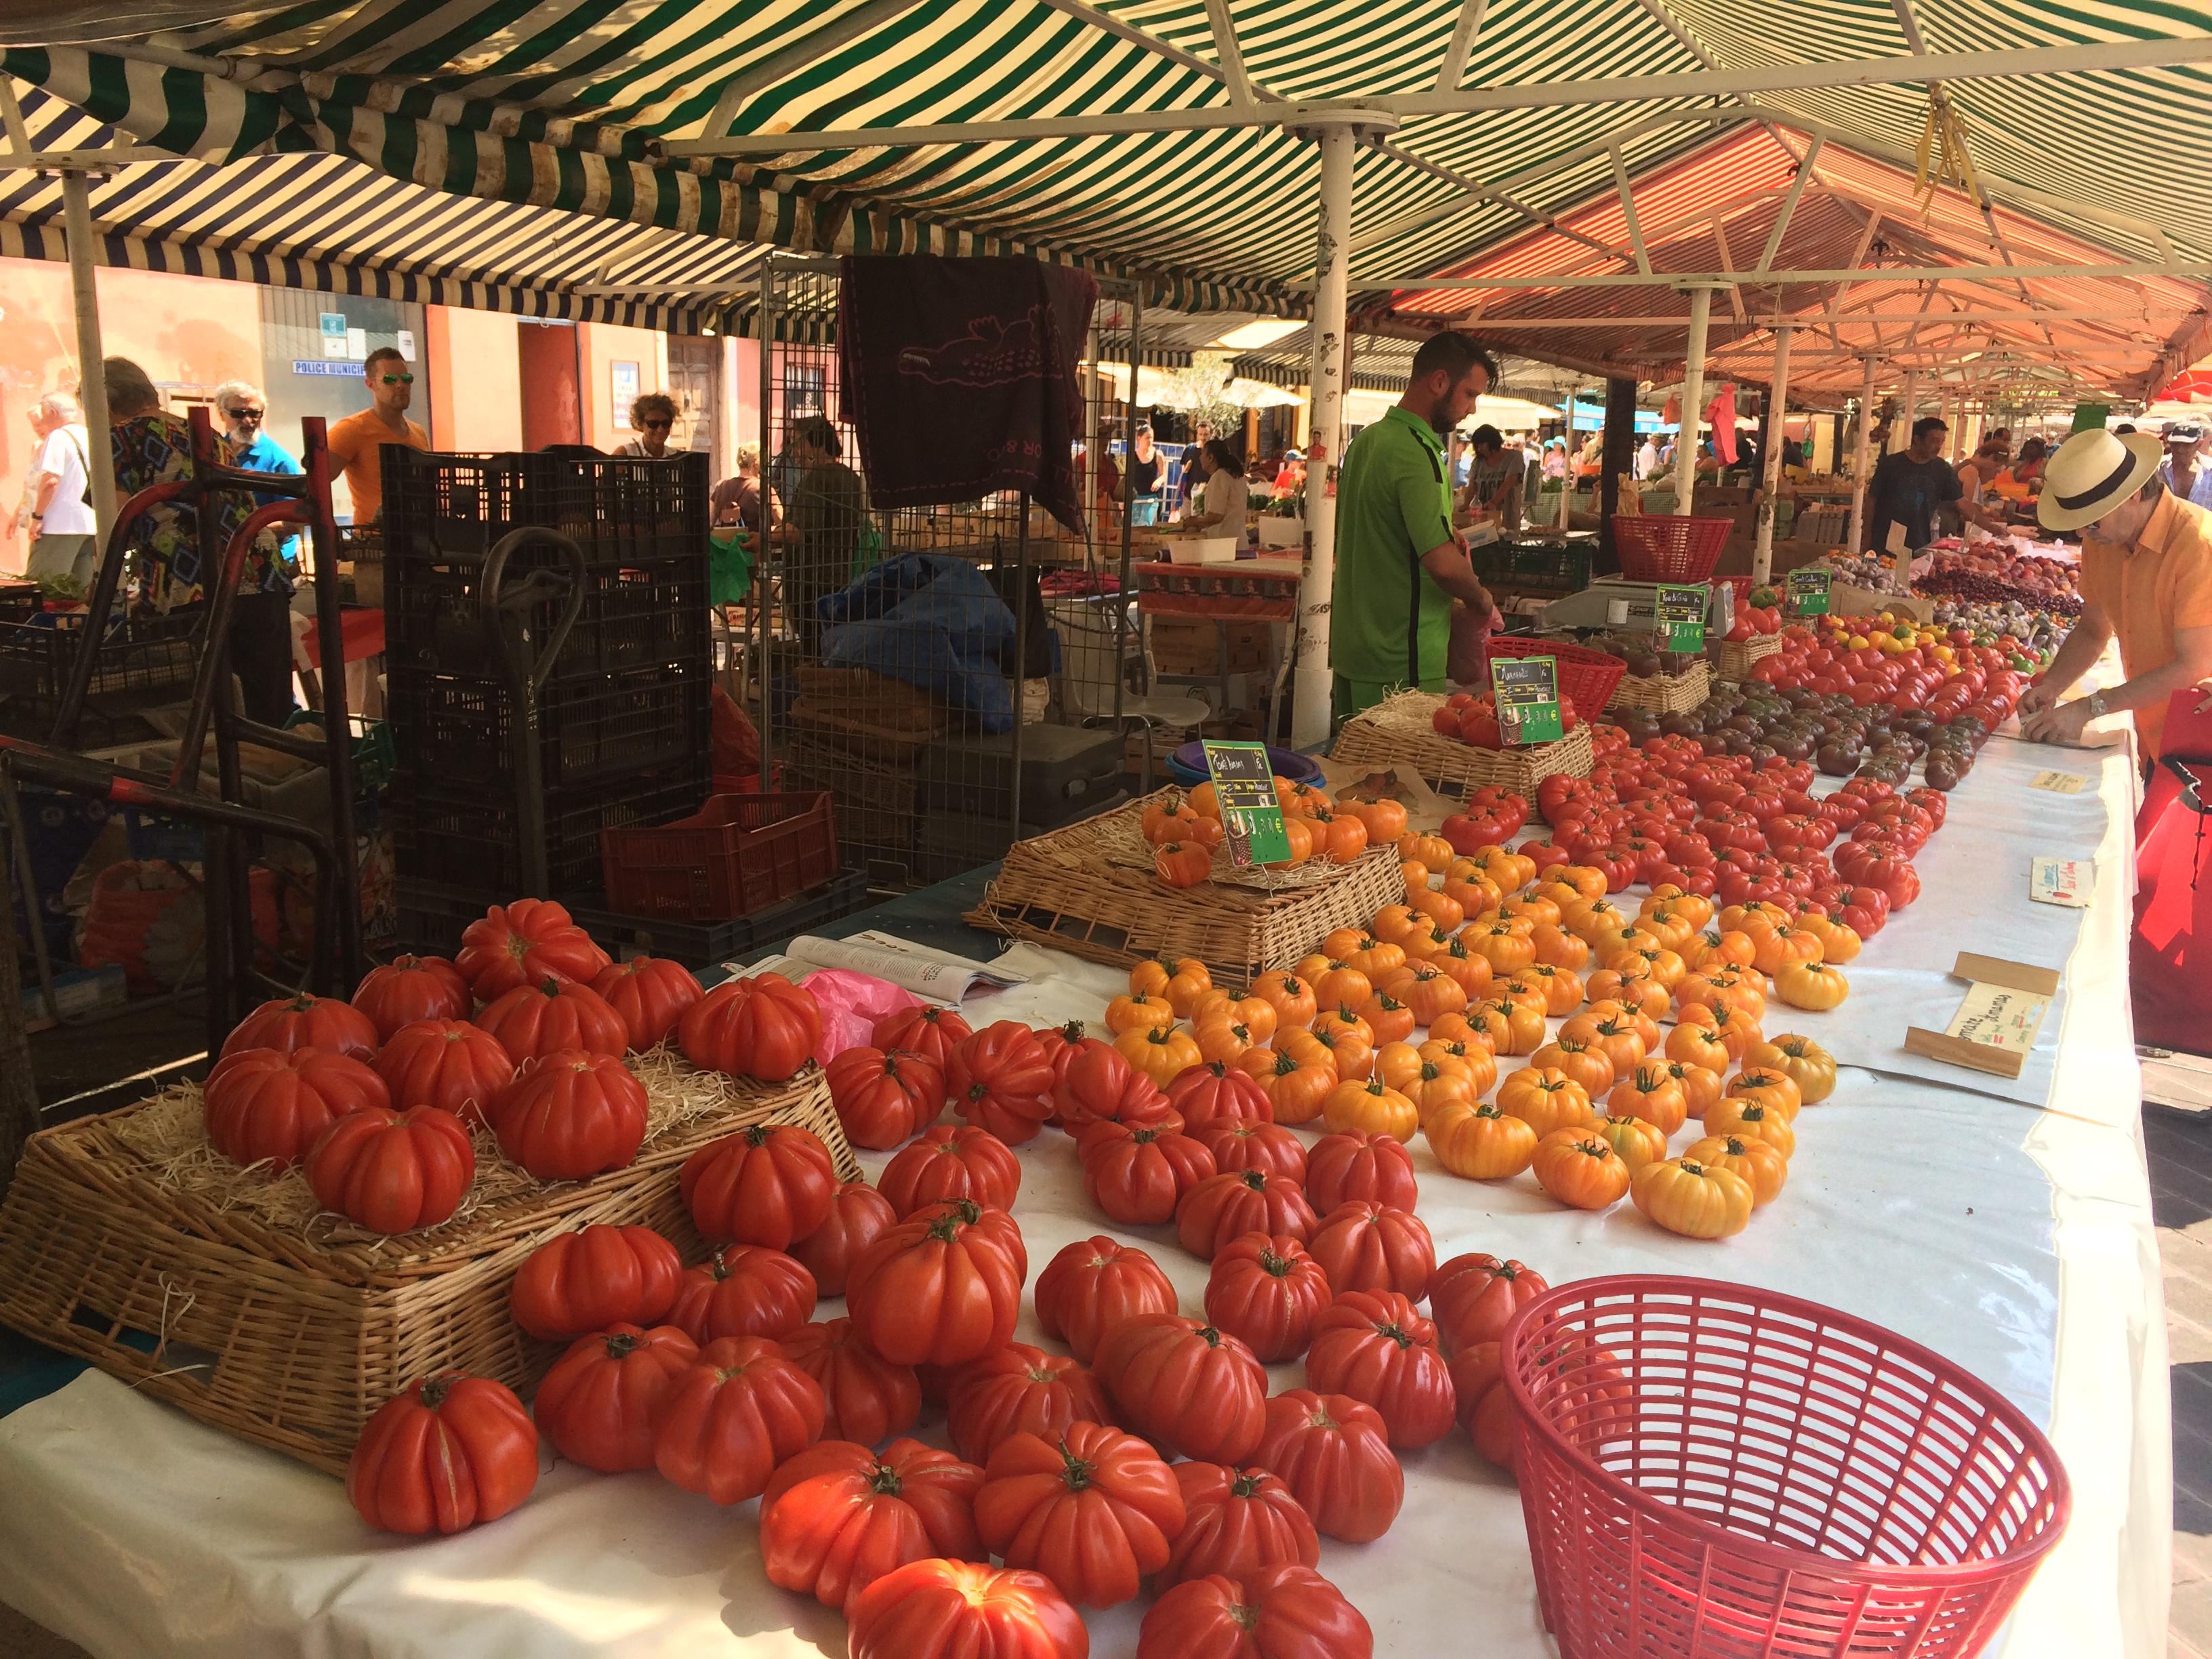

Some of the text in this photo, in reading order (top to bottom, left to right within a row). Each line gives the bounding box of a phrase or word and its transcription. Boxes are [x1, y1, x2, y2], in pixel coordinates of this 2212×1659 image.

[295, 362, 367, 375] POLICE MUNICIP
[1551, 710, 1557, 721] €
[1275, 818, 1283, 834] €
[1958, 1015, 1985, 1042] omate
